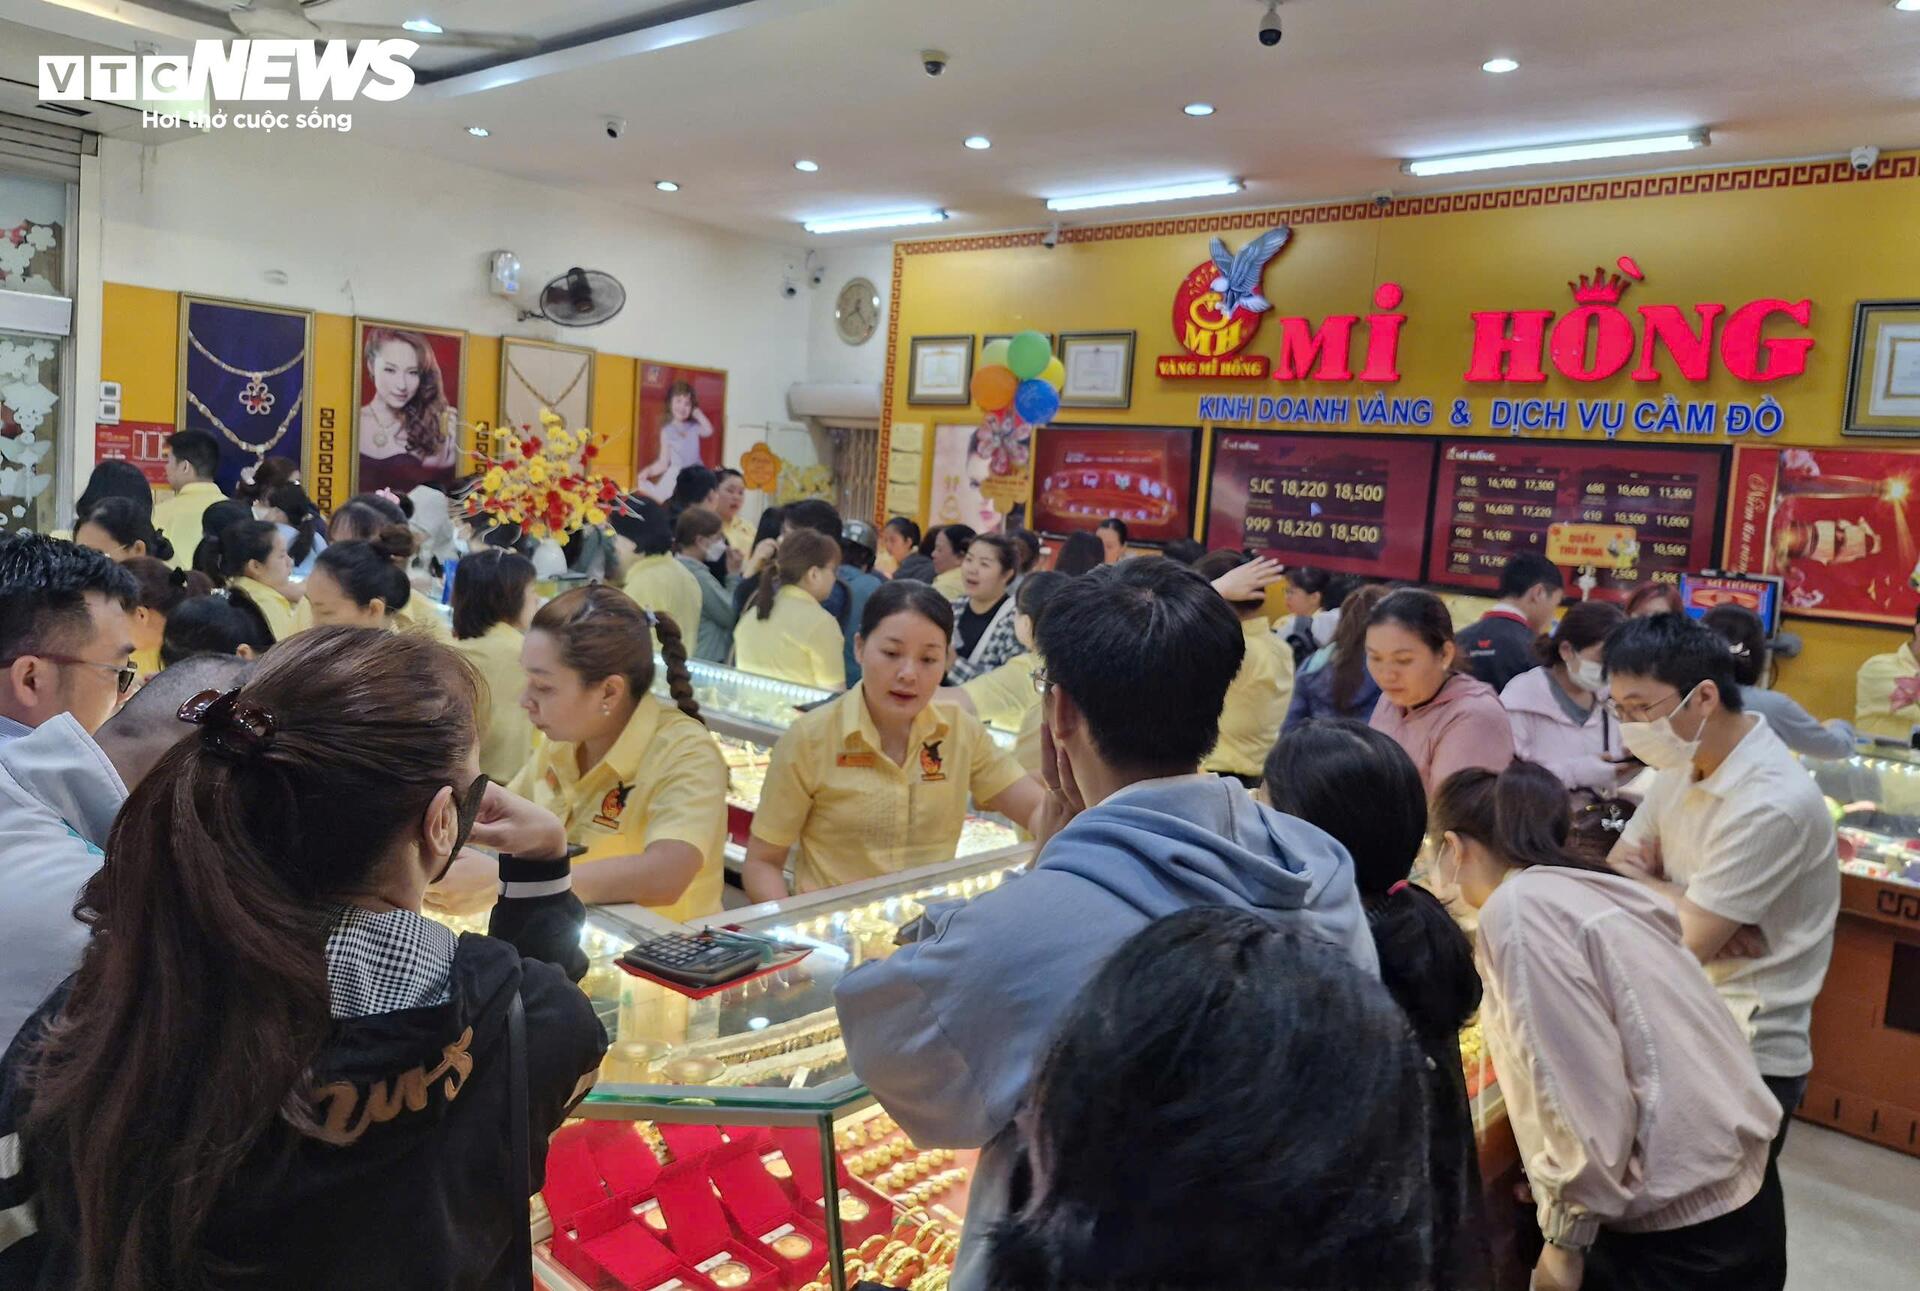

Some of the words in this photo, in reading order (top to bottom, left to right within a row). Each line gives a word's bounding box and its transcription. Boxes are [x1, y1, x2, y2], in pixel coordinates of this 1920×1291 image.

[1199, 395, 1251, 422] KINH
[1256, 396, 1350, 425] DOANH
[1357, 392, 1432, 427] VÀNG
[1450, 399, 1472, 427] &
[1489, 399, 1567, 434] DỊCH
[1577, 399, 1626, 437] VỤ
[1632, 393, 1717, 434] CẦM
[1724, 394, 1785, 437] ĐỒ
[1250, 477, 1276, 494] SJC
[1281, 479, 1327, 499] 18,220
[1334, 482, 1384, 503] 18,500
[1246, 516, 1271, 533] 999
[1276, 518, 1323, 538] 18,220
[1330, 523, 1379, 544] 18,500
